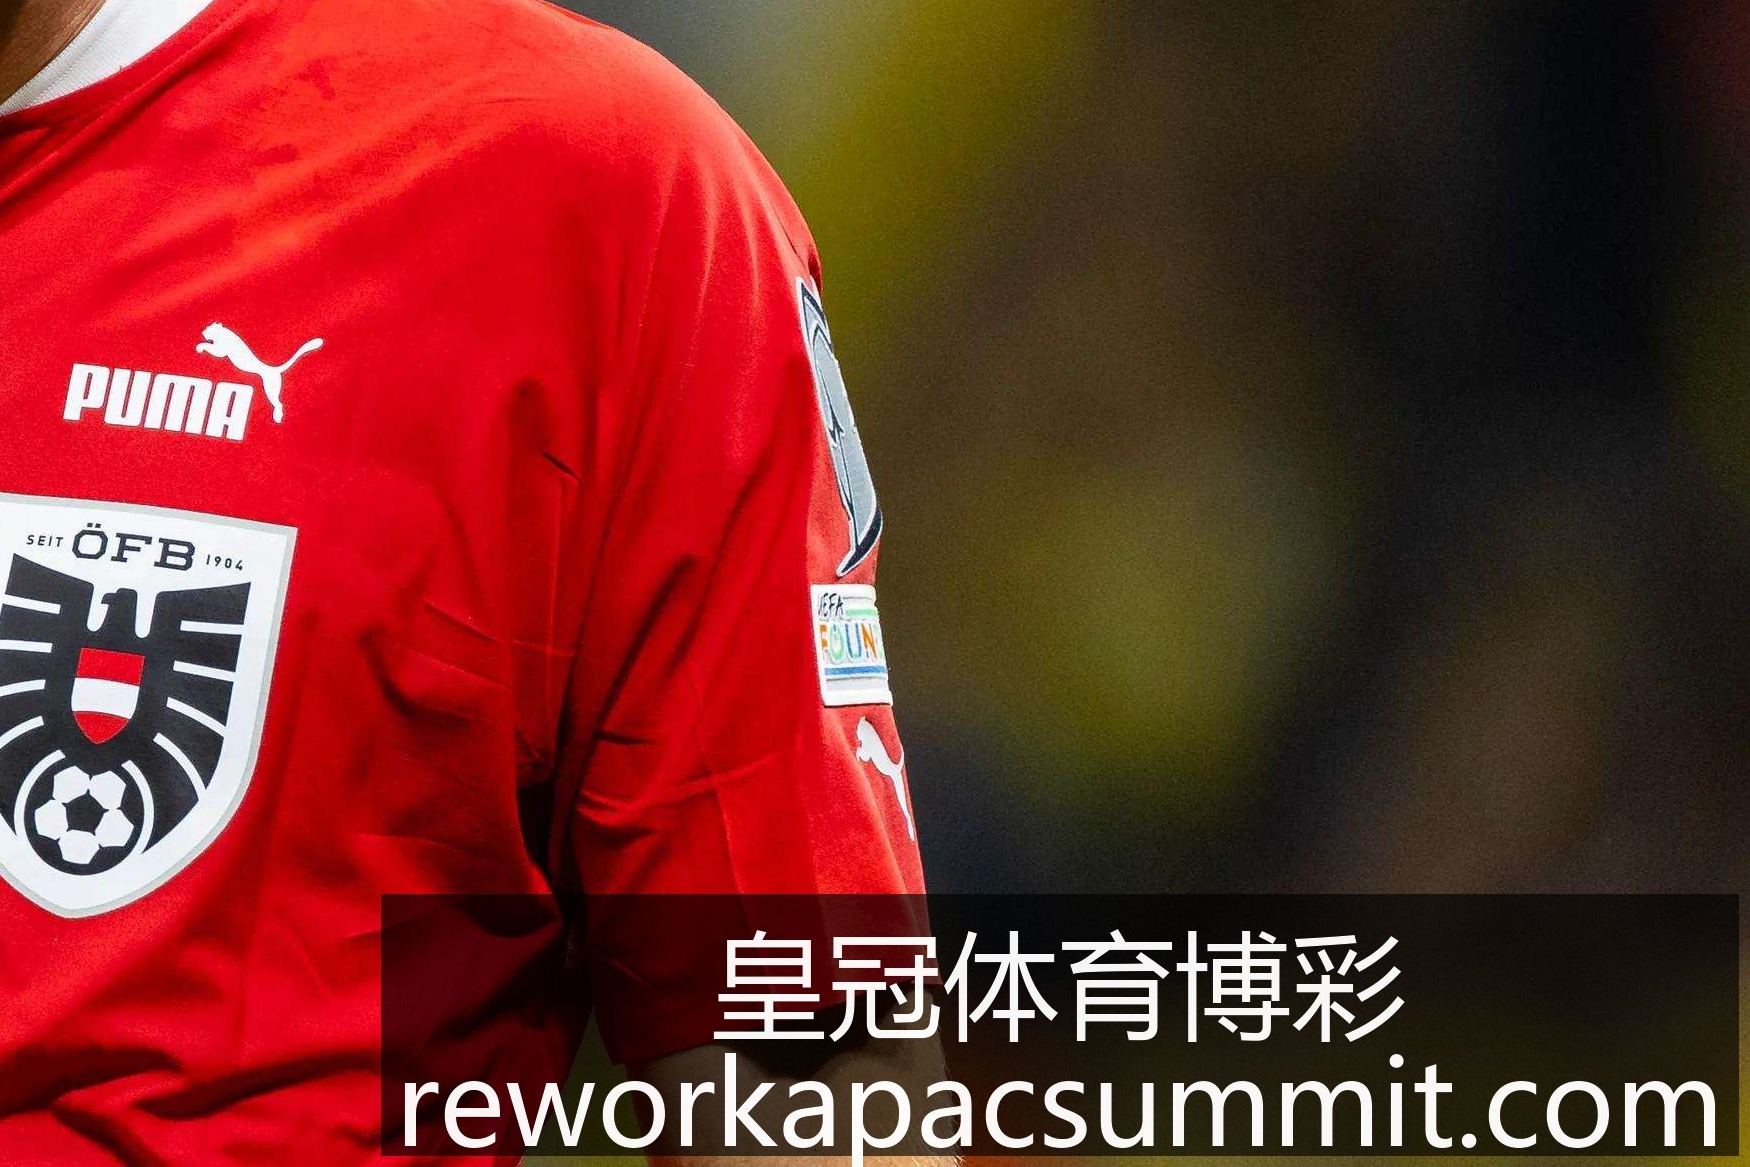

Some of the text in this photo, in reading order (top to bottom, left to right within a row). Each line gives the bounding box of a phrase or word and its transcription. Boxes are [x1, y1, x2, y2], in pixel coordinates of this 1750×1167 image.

[62, 363, 254, 441] PUMA
[26, 522, 244, 572] SEIT ÖFB 1904
[820, 622, 884, 663] FOUN
